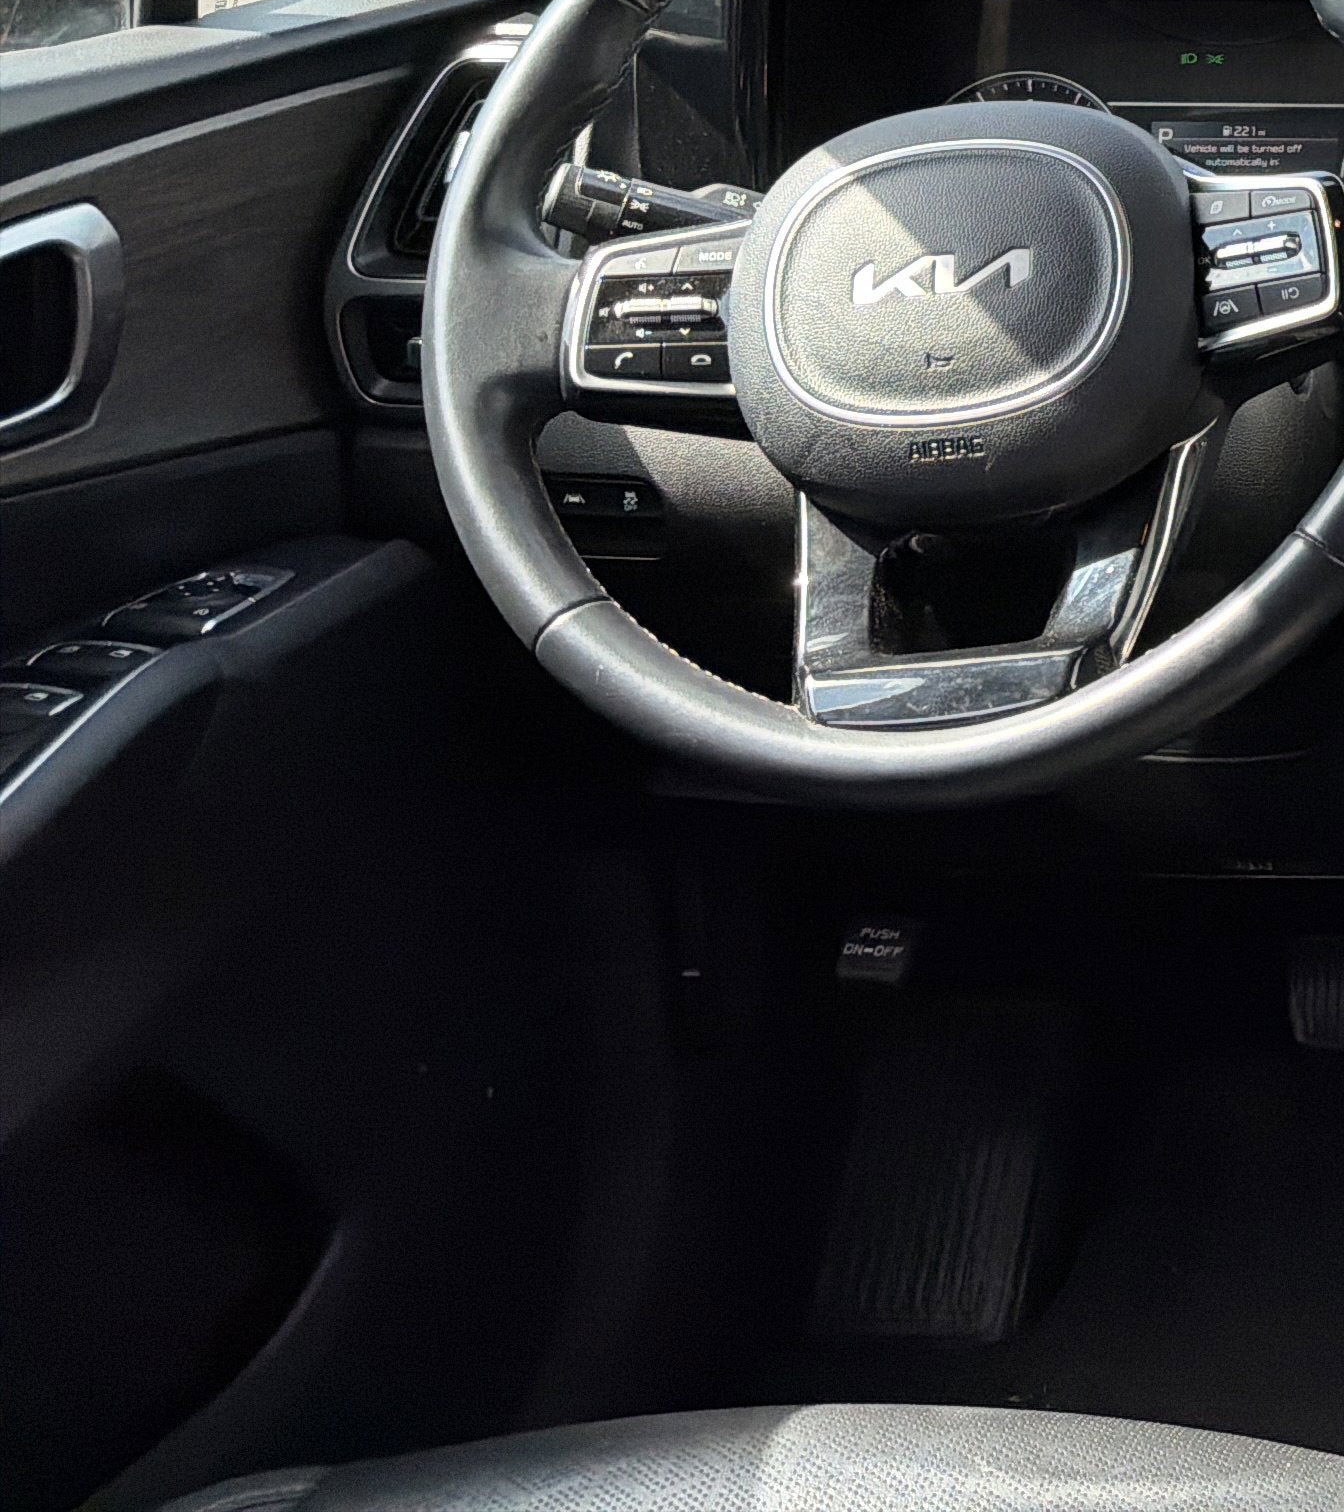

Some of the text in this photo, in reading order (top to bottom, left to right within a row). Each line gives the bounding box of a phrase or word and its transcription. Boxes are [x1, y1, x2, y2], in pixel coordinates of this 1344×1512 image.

[1158, 128, 1173, 143] P
[1233, 126, 1256, 137] 221
[1184, 144, 1217, 153] Vehicle
[1252, 144, 1284, 153] turned
[1287, 145, 1302, 153] off
[1205, 158, 1268, 168] automatically
[622, 220, 643, 230] AUTO
[699, 251, 733, 261] MODE
[852, 248, 1031, 305] KIA
[909, 438, 985, 461] AIRBAG
[860, 928, 900, 939] PUSH
